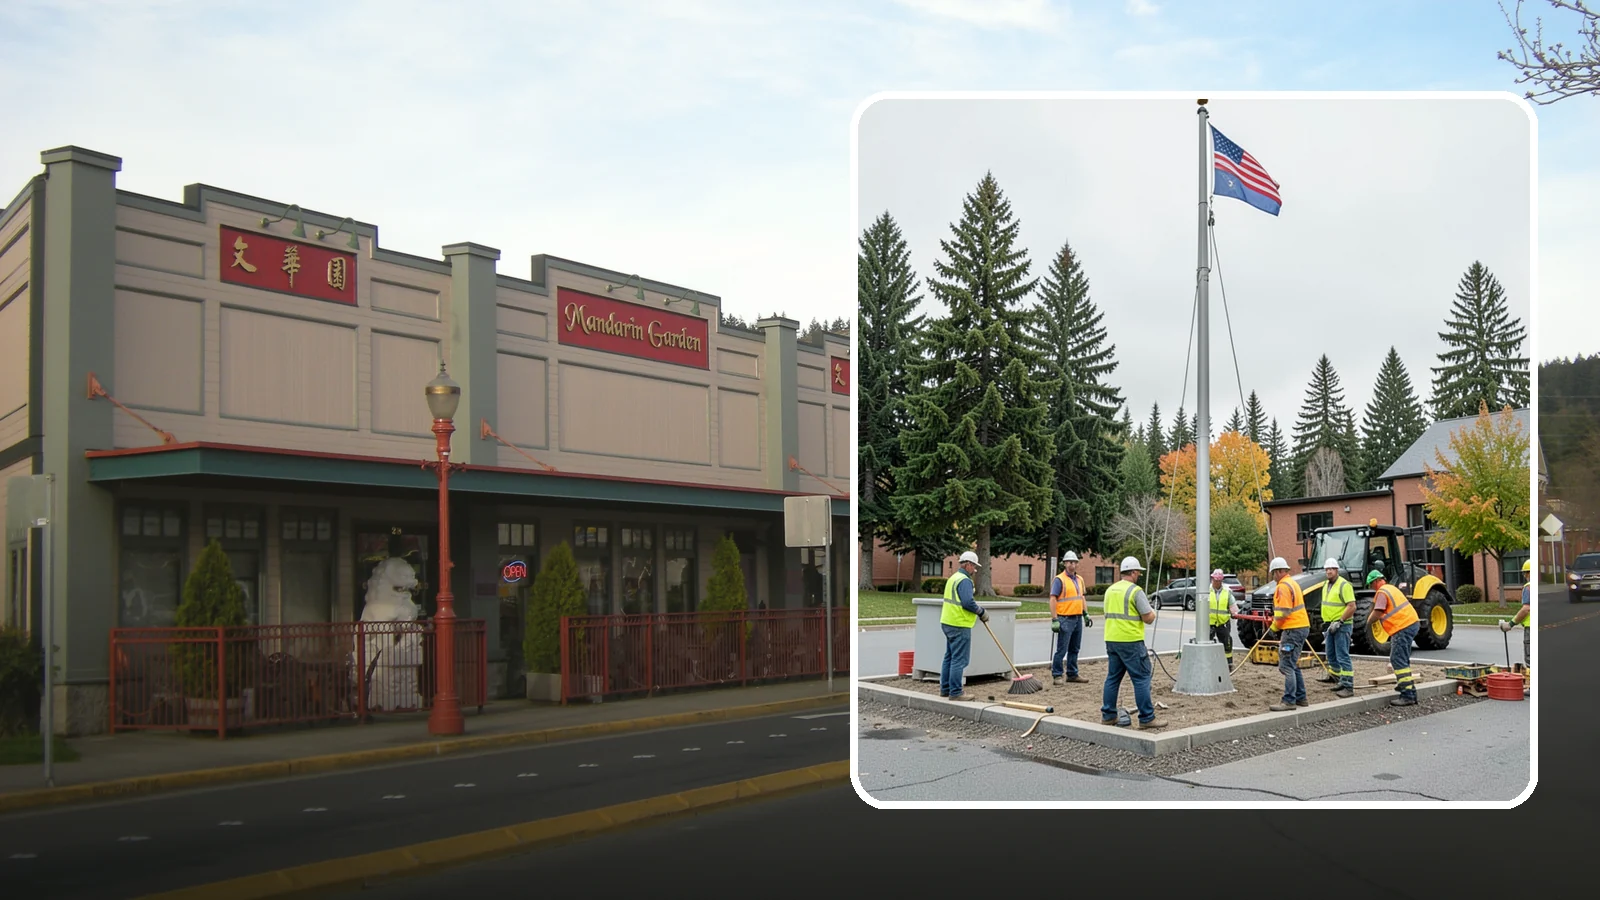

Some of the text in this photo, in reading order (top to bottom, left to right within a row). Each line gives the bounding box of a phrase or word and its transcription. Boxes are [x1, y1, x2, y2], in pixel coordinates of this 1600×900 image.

[230, 235, 346, 291] 文華園
[564, 302, 702, 352] Mandarin Garden
[503, 565, 527, 578] OPEN
